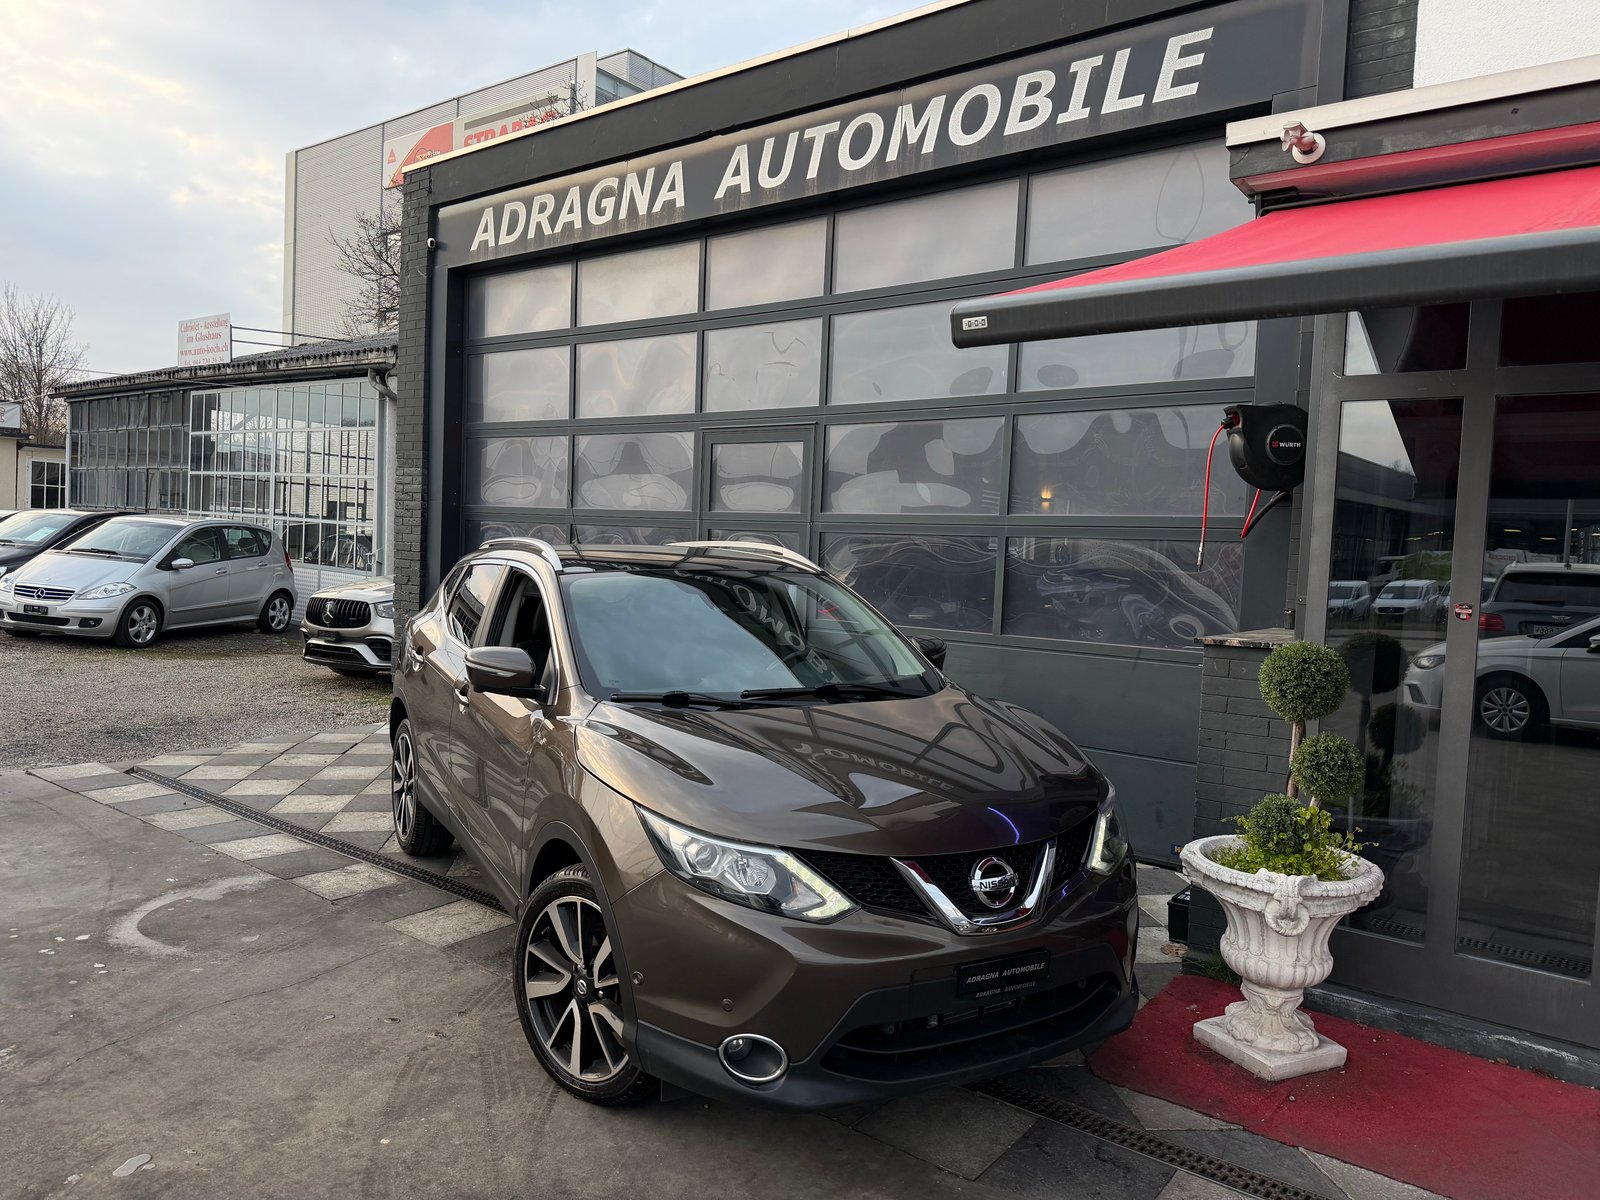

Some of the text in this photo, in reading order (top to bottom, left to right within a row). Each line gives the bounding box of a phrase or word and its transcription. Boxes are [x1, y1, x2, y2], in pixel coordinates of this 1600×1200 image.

[470, 27, 1214, 252] ADRAGNA AUTOMOBILE
[195, 330, 222, 342] Glashaus
[180, 342, 229, 356] www.auto-koch.ch
[966, 962, 1046, 984] ADRAGNA AUTOMOBILE
